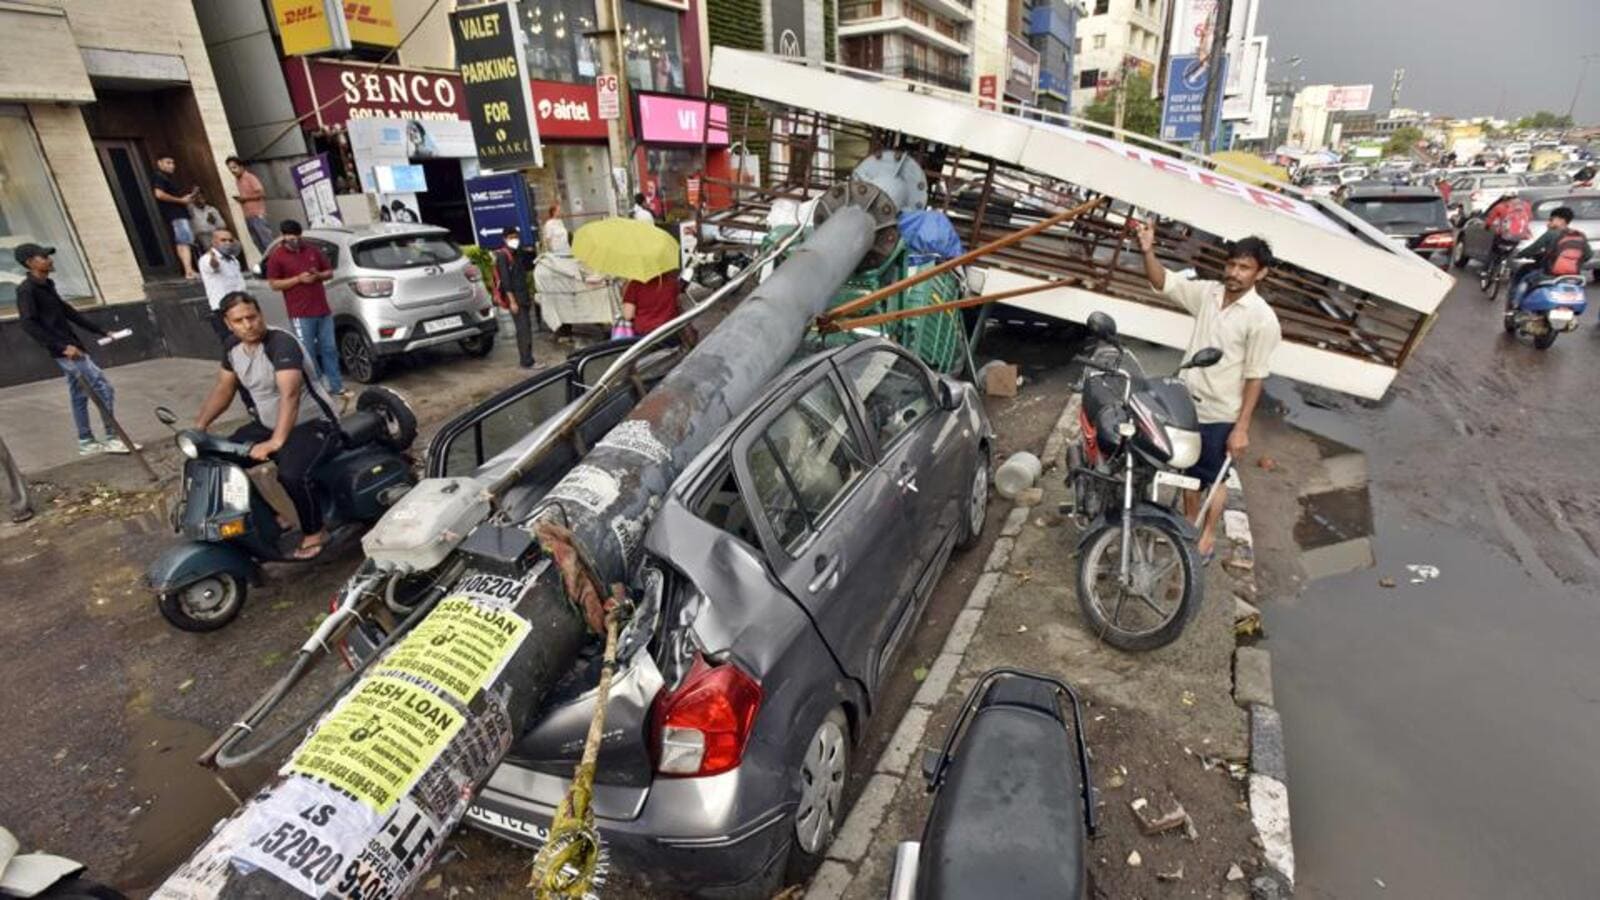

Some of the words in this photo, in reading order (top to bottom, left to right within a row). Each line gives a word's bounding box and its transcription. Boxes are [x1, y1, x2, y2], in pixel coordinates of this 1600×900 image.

[459, 13, 500, 41] VALET
[461, 56, 518, 85] PARKING
[599, 77, 618, 92] PG
[341, 71, 456, 107] SENCO
[483, 101, 511, 124] FOR
[553, 98, 590, 121] airtel
[361, 681, 408, 701] CASH
[404, 692, 454, 731] LOAN
